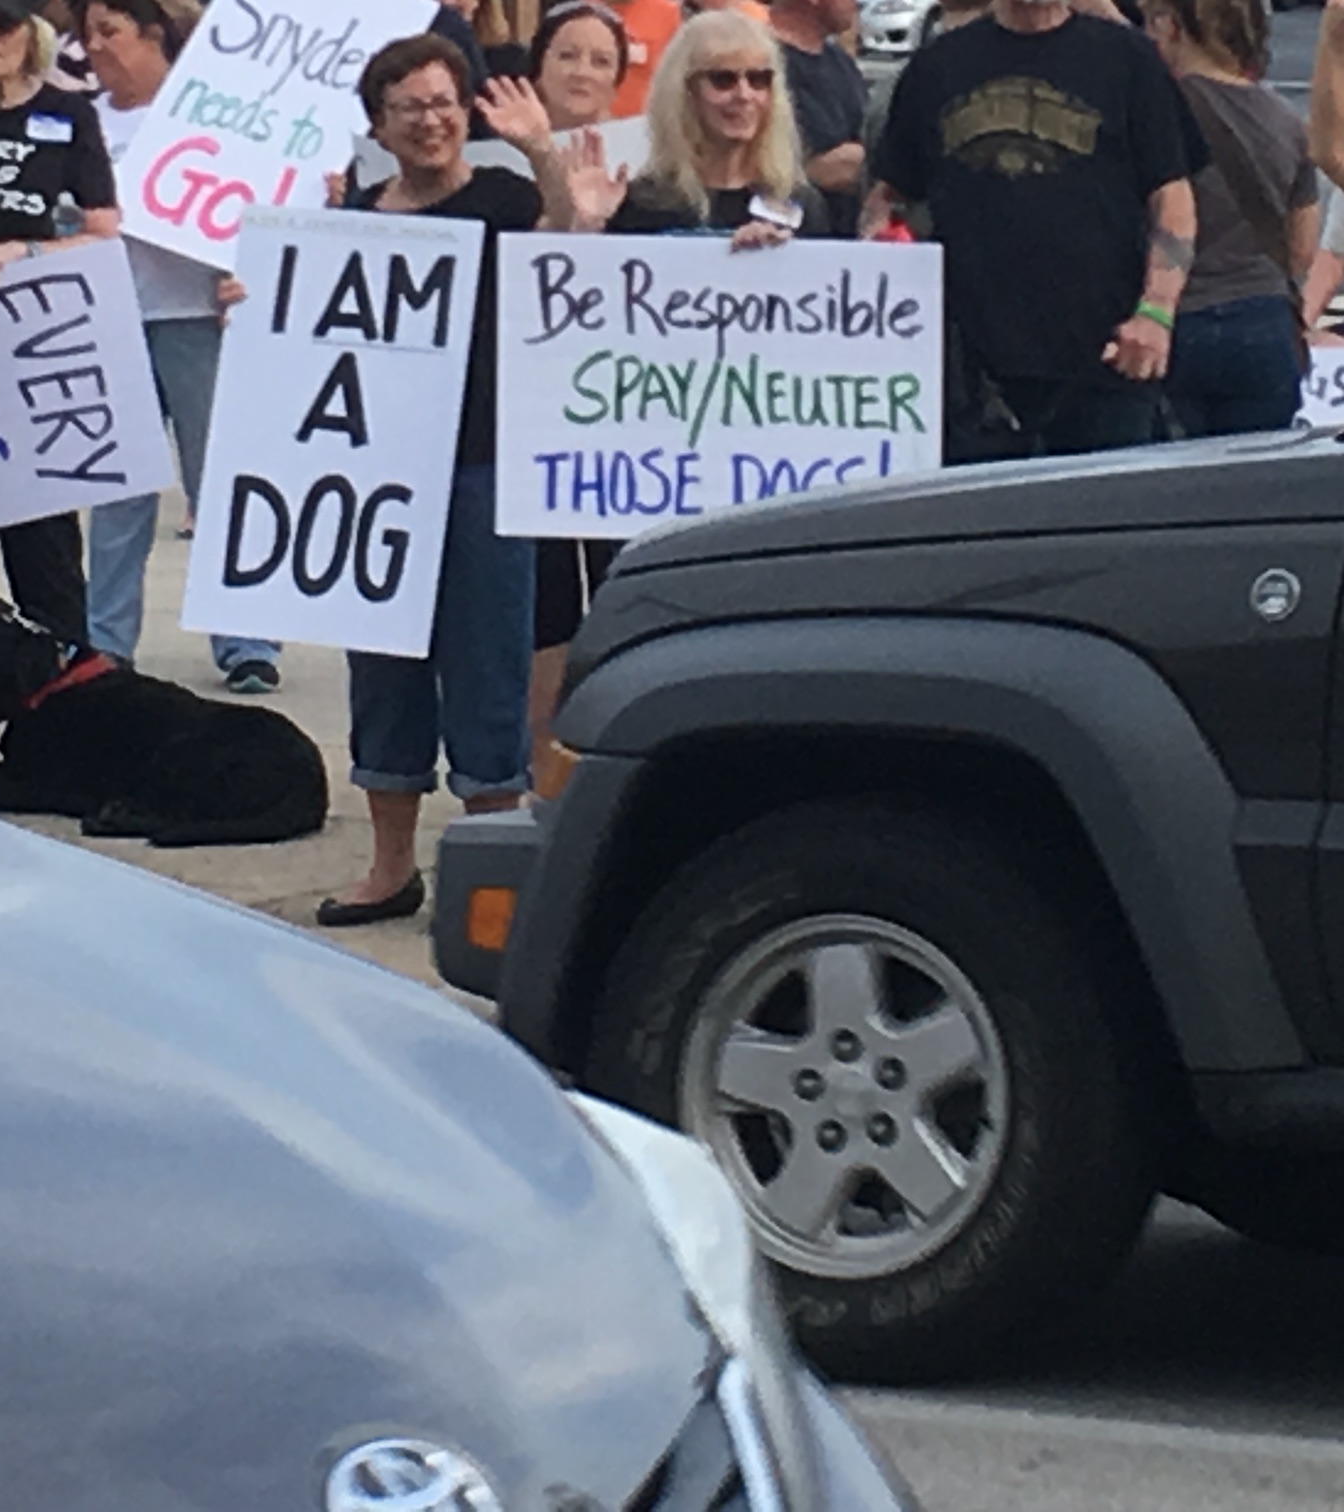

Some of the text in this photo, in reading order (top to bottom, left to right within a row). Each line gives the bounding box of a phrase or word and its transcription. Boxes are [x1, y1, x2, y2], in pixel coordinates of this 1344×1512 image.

[168, 76, 325, 159] needs to
[271, 244, 457, 348] I AM
[523, 251, 925, 358] Be Responsible
[294, 350, 370, 449] A
[562, 349, 926, 449] SPAY/NEUTER
[533, 448, 704, 518] THOSE
[222, 473, 415, 604] DOG
